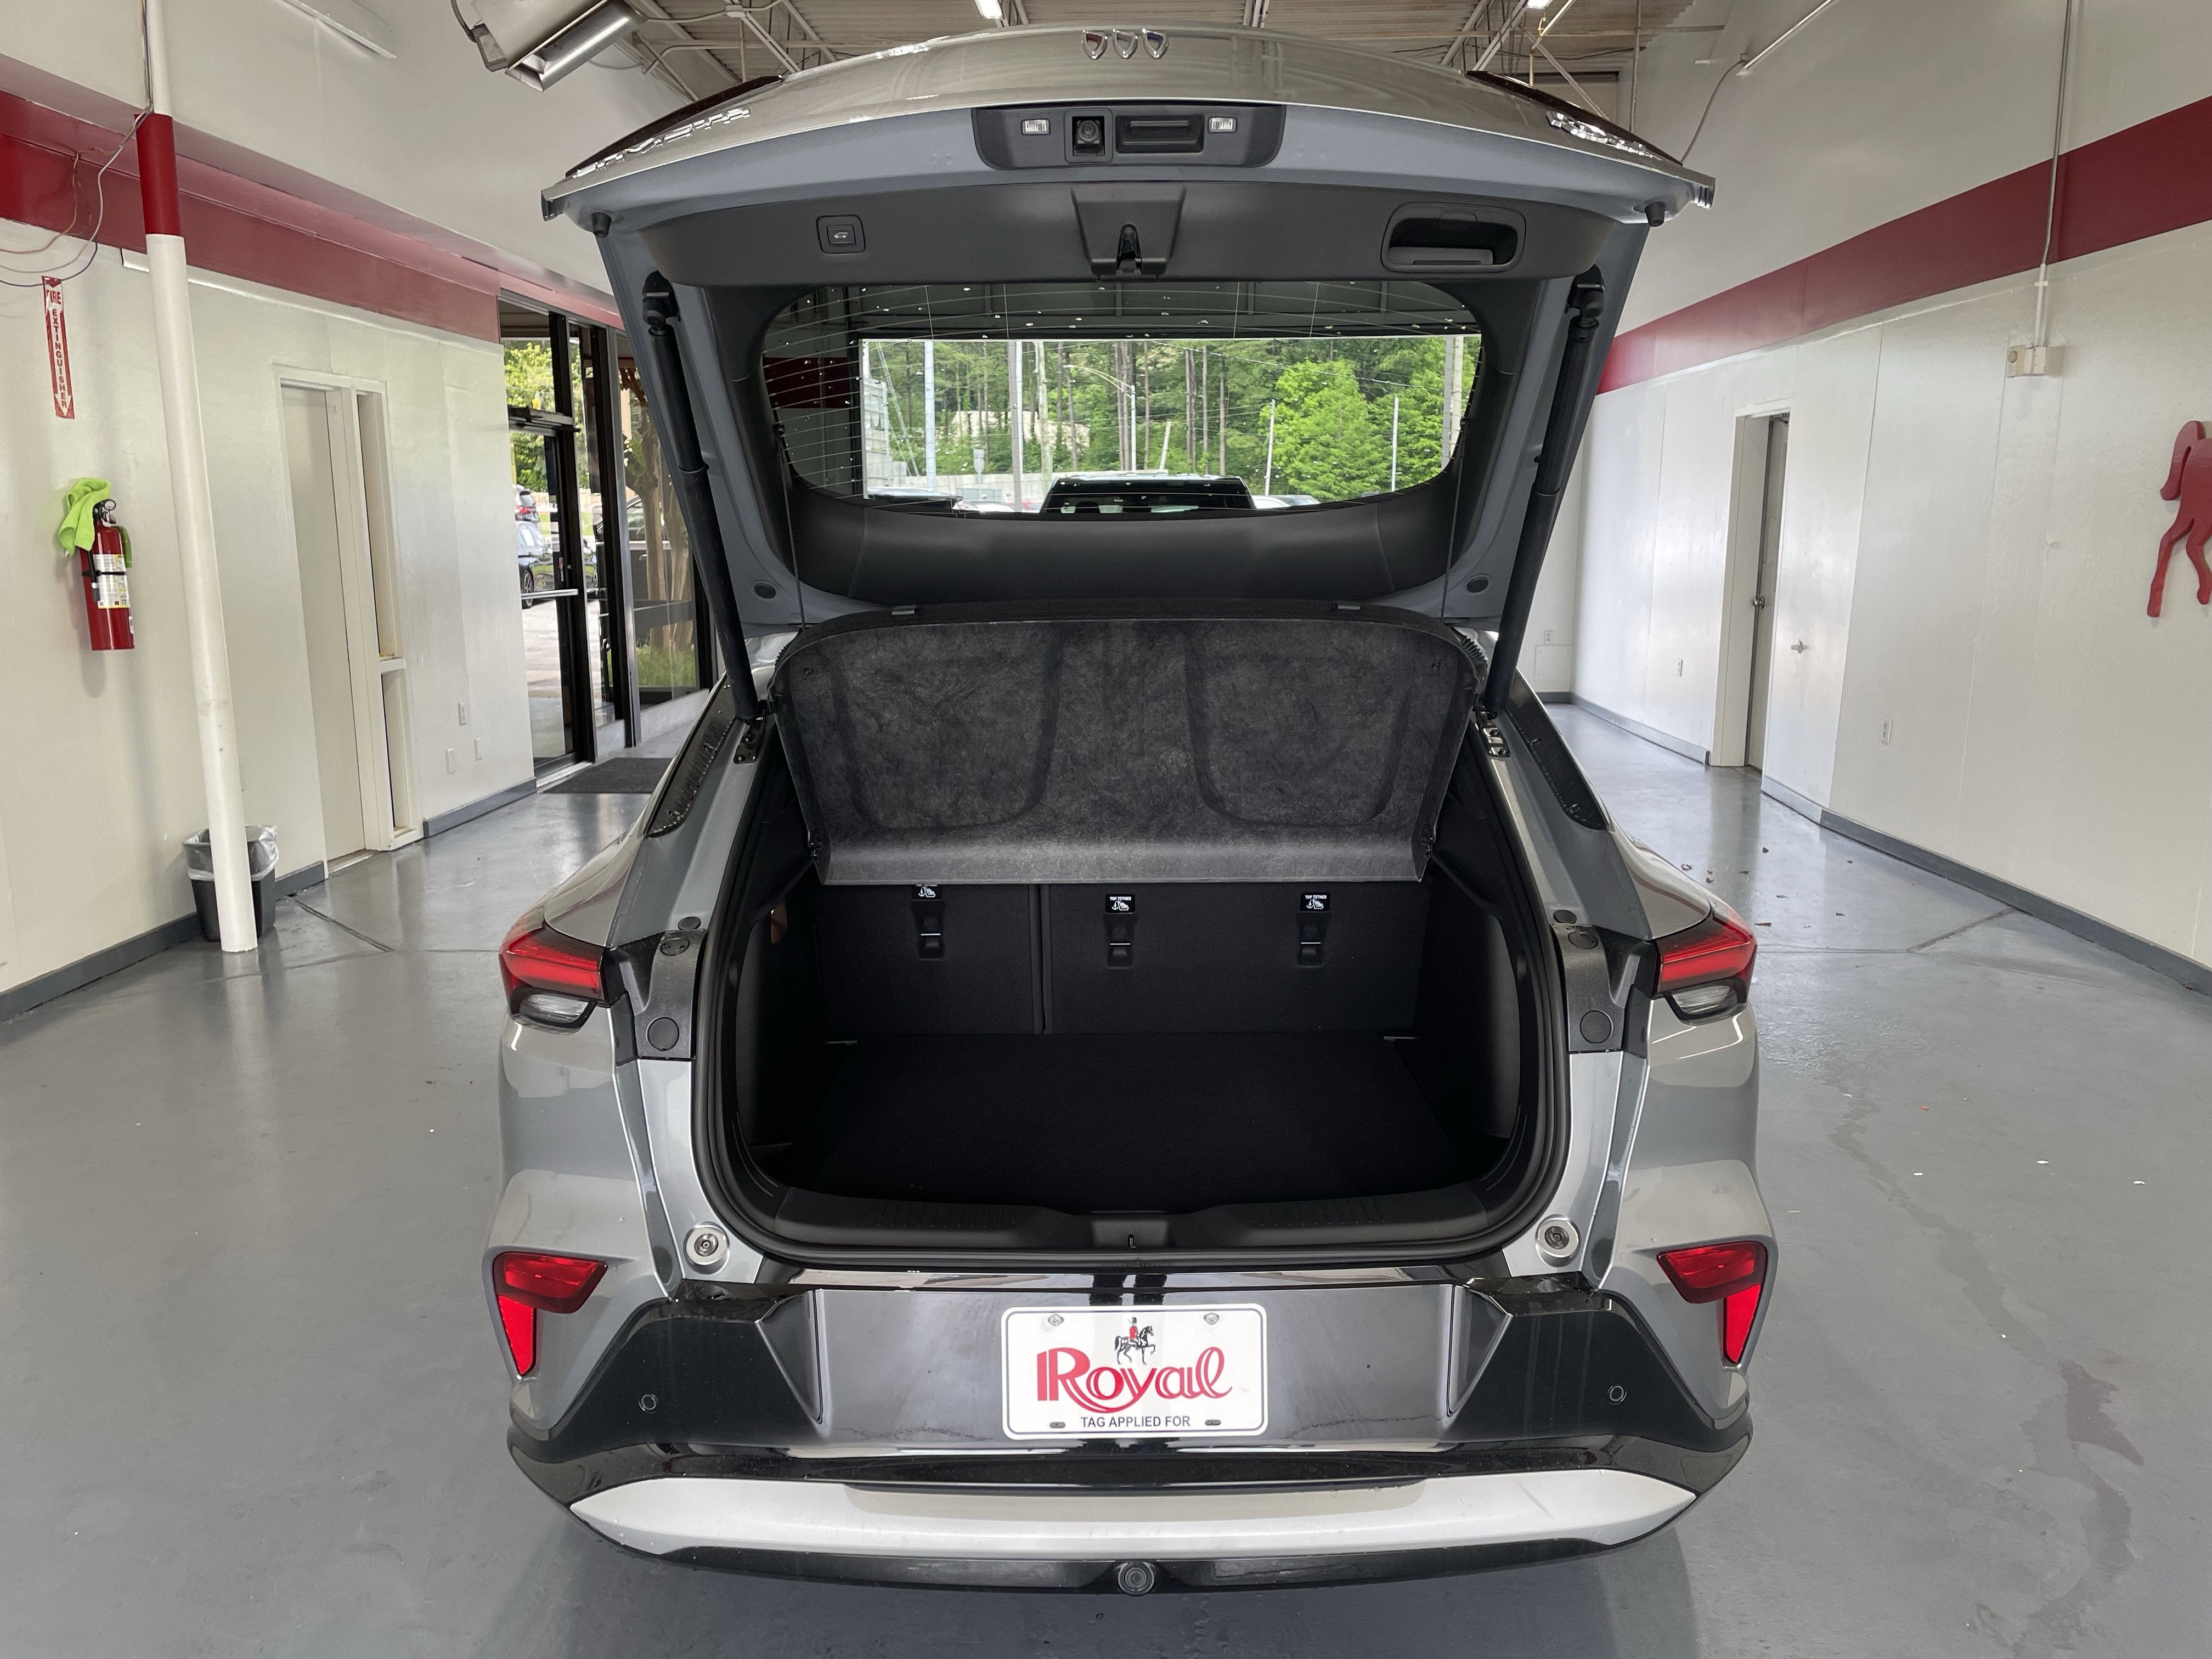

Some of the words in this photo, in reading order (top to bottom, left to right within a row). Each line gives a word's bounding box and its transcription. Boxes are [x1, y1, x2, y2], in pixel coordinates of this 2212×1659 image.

[52, 309, 67, 408] EXTINGUISHER
[1037, 1347, 1233, 1413] Royal
[1080, 1417, 1105, 1428] TAG
[1109, 1415, 1161, 1427] APPLIED
[1165, 1415, 1191, 1427] FOR
